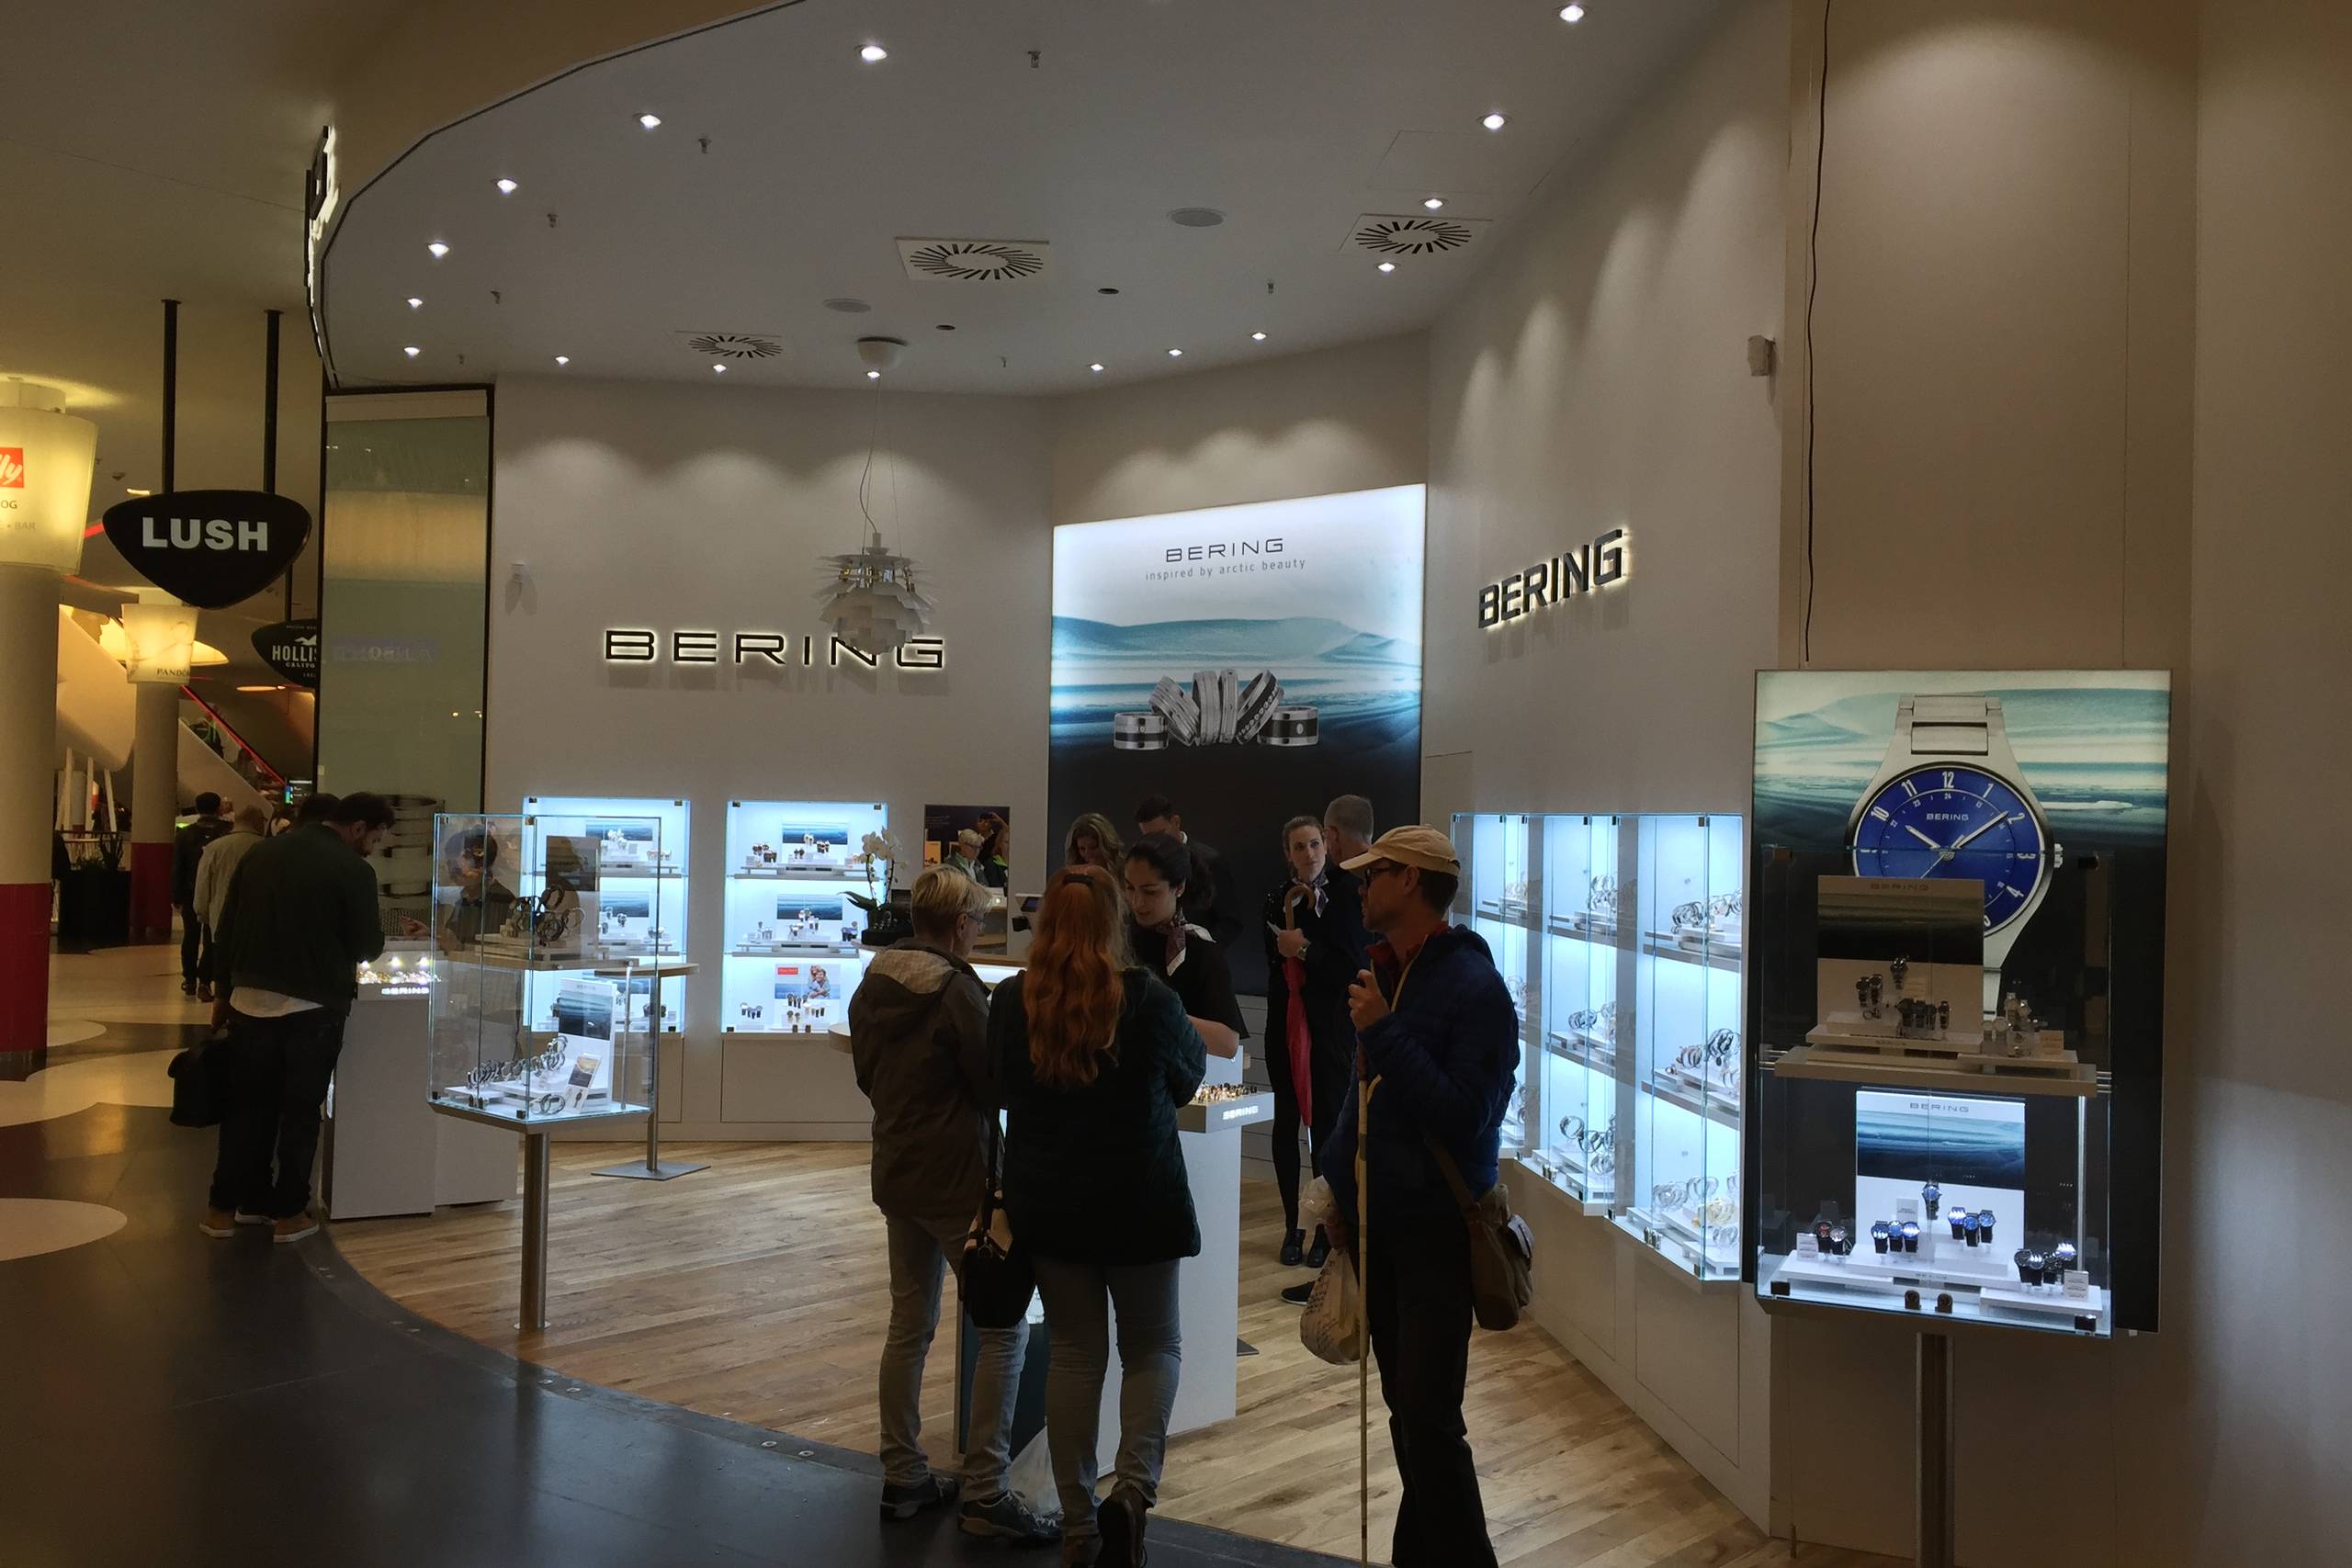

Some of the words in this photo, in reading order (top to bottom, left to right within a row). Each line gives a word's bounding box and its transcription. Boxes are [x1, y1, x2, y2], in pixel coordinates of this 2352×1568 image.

[141, 517, 268, 551] LUSH
[1166, 538, 1283, 562] BERING
[1146, 567, 1193, 581] inspired
[1200, 566, 1213, 578] by
[1219, 562, 1255, 575] arctic
[1261, 558, 1306, 571] beauty
[1477, 528, 1623, 629] BERING
[605, 629, 944, 669] BERING
[1901, 779, 1918, 797] 11
[1942, 771, 1954, 789] 12
[1983, 783, 1994, 798] 1
[1870, 806, 1890, 821] 10
[2007, 812, 2026, 826] 2
[2006, 886, 2025, 898] 4
[1222, 1106, 1259, 1120] BERING
[1910, 1102, 1970, 1112] BERING
